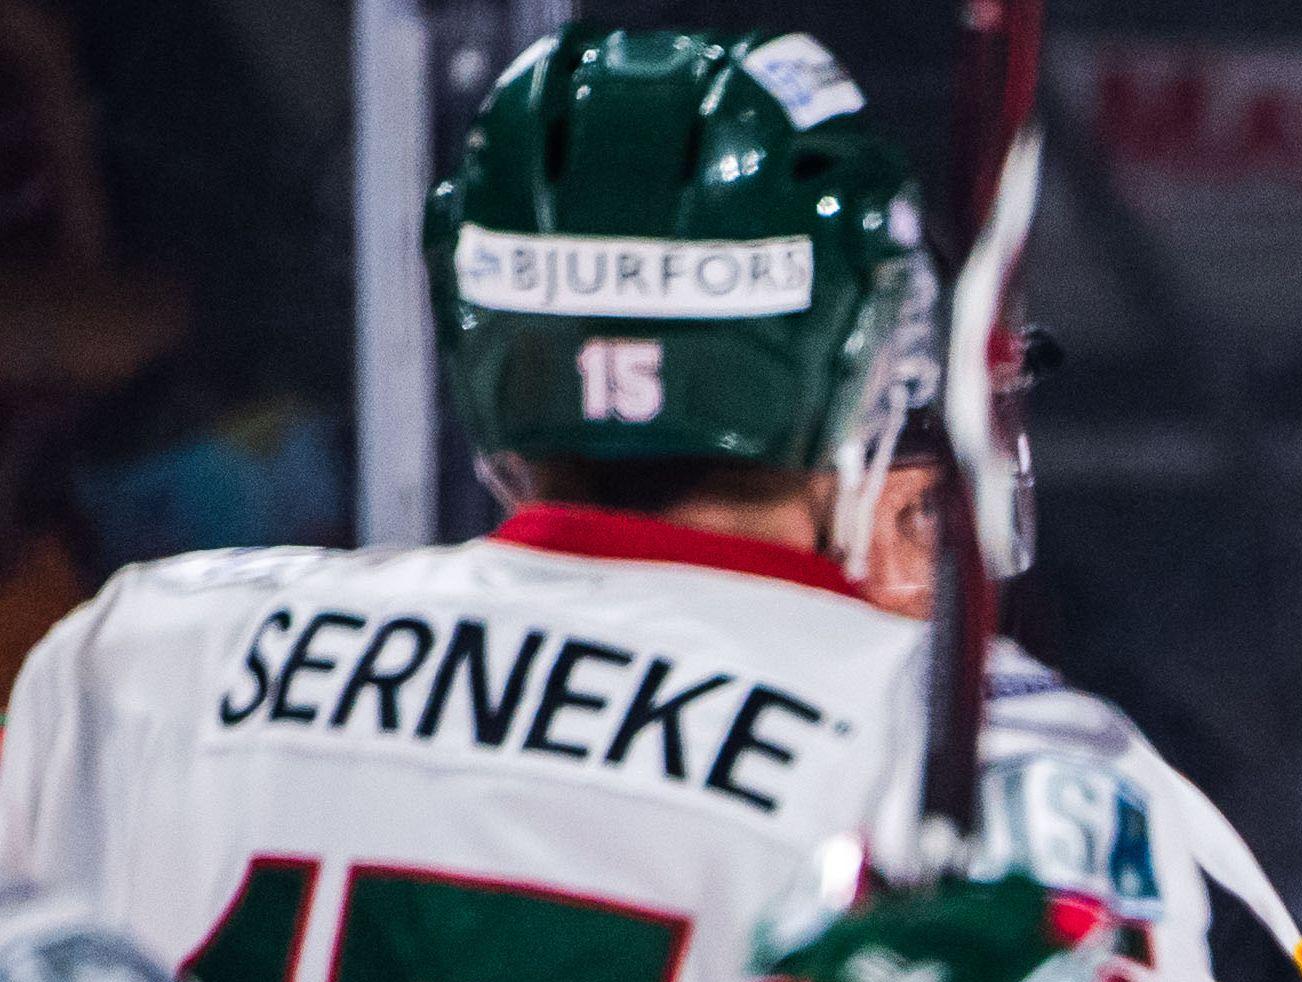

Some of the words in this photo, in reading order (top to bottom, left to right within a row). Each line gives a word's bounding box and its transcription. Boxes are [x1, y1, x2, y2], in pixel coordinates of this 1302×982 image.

[509, 246, 806, 302] BJURFORS
[578, 338, 663, 422] 15
[218, 608, 823, 813] SERNEKE
